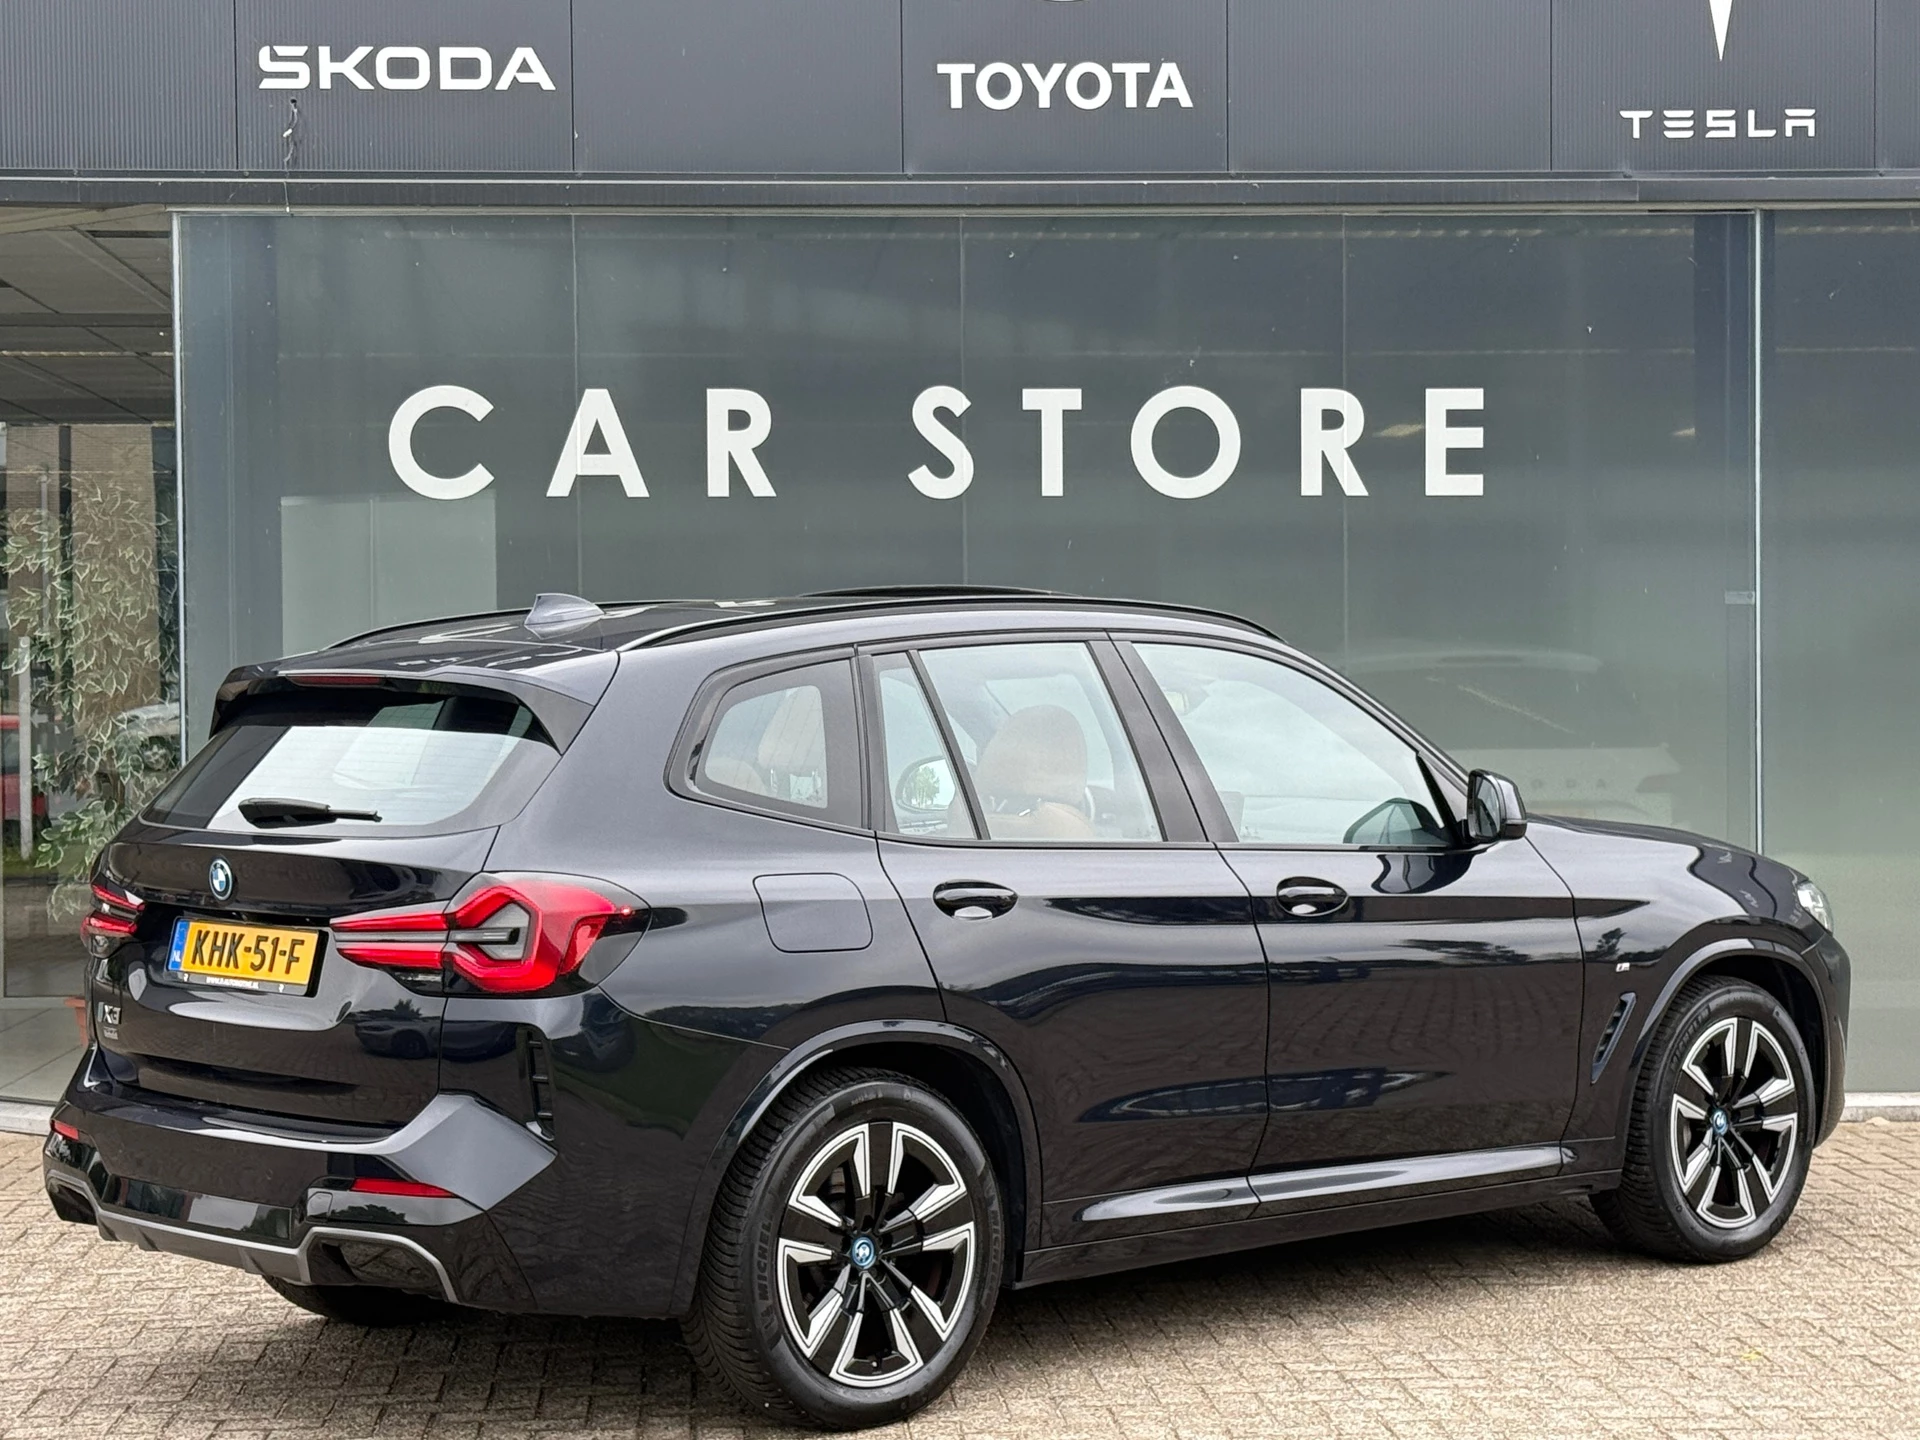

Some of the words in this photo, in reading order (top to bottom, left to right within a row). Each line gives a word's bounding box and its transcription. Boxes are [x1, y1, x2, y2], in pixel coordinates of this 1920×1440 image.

[937, 62, 1194, 111] TOYOTA
[1619, 108, 1817, 139] TESLA
[388, 385, 777, 500] CAR
[908, 385, 1484, 500] STORE
[172, 950, 181, 962] NL
[190, 929, 306, 975] KHK-51-F
[756, 1206, 773, 1301] MICHEL
